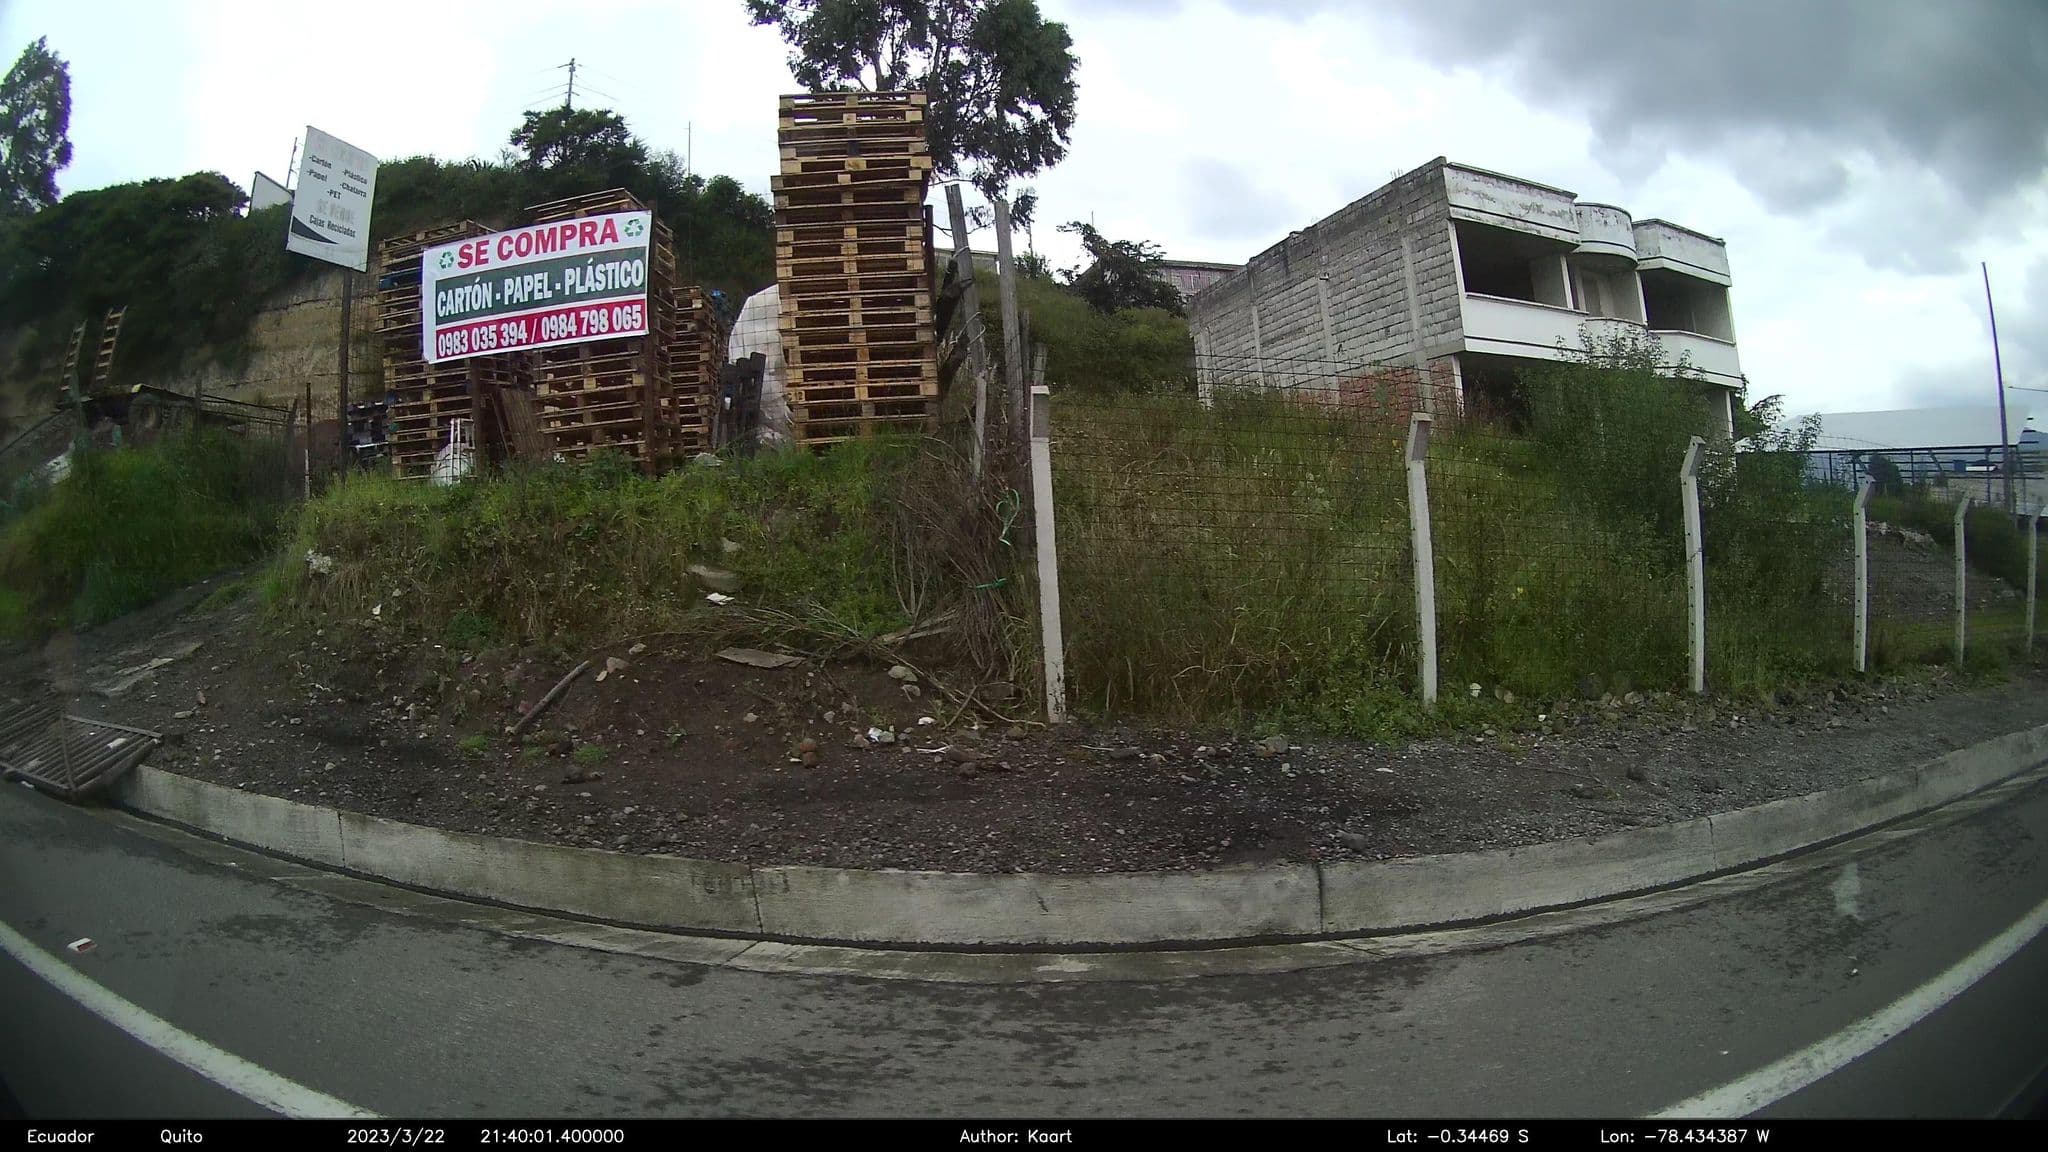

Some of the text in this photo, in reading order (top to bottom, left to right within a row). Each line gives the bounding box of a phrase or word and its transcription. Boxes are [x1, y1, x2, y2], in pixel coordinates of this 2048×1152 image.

[327, 189, 342, 200] -PET
[457, 217, 619, 269] SE COMPRA
[437, 276, 493, 318] CARTÓN
[504, 270, 553, 306] PAPEL
[564, 256, 644, 296] PLÁSTICO
[437, 328, 469, 357] 0983
[471, 324, 498, 352] 035
[500, 318, 529, 347] 394
[541, 311, 578, 341] 0984
[580, 307, 610, 336] 798
[612, 303, 643, 332] 065
